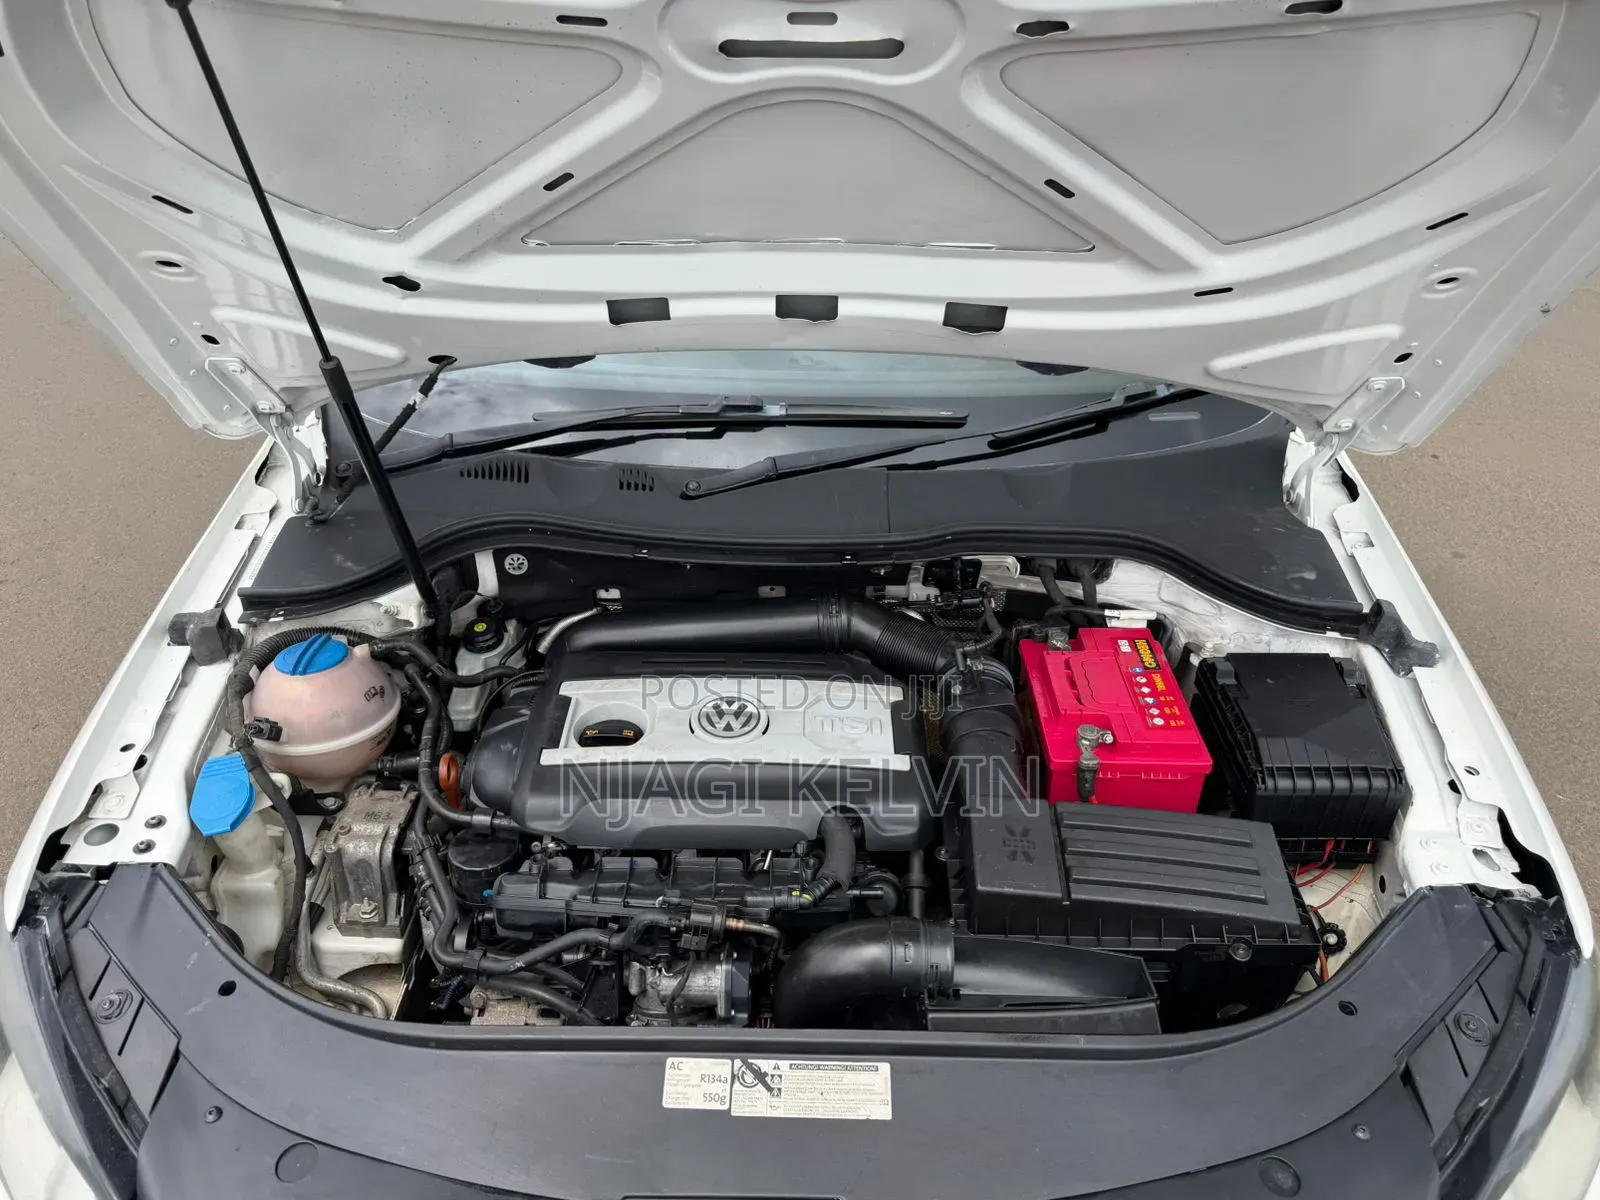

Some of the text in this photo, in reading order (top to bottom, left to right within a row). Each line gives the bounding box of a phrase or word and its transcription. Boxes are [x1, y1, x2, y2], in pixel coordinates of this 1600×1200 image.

[814, 715, 883, 737] TSI
[668, 1061, 684, 1071] AC
[700, 1073, 728, 1084] R134a
[703, 1092, 727, 1106] 550g
